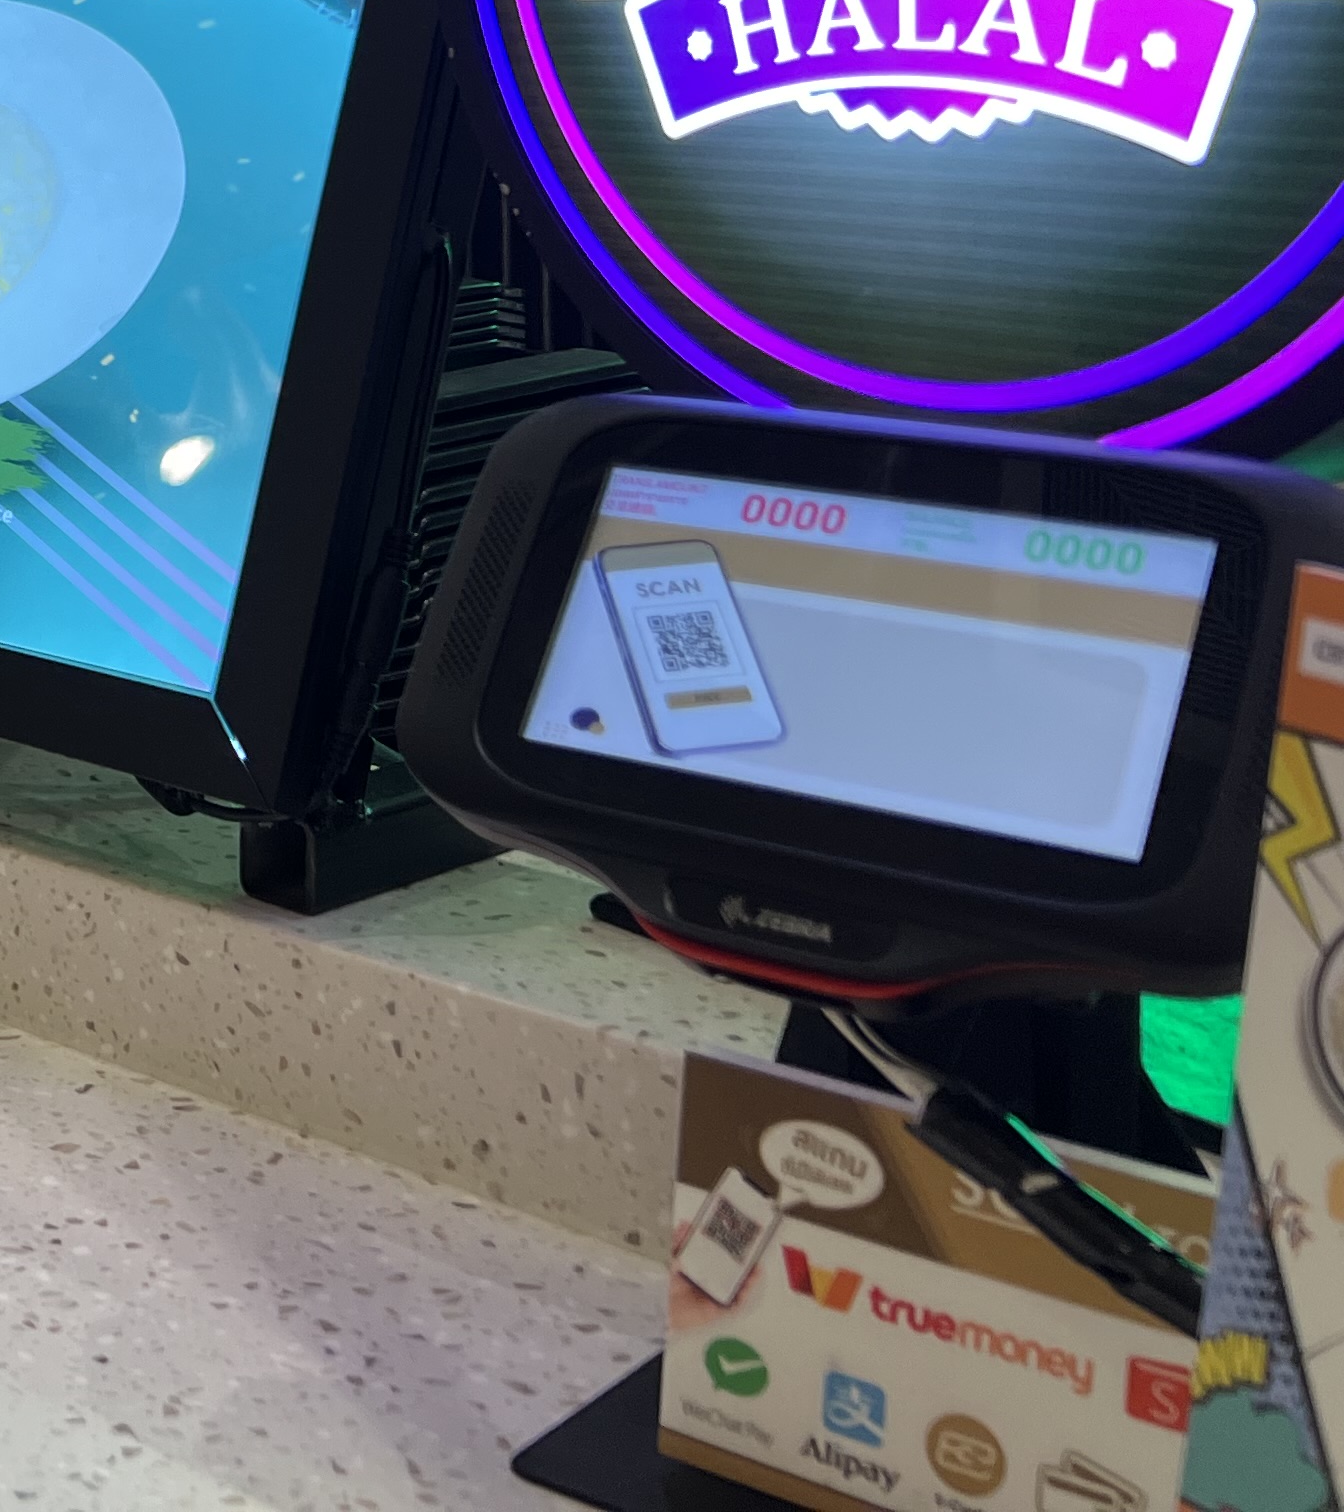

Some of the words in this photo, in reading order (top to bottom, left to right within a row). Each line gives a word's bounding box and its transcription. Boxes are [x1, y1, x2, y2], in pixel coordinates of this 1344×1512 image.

[741, 493, 846, 535] 0000
[1023, 526, 1145, 575] 0000
[635, 578, 702, 599] SCAN
[870, 1286, 1095, 1398] truemoney
[799, 1437, 901, 1492] Alipay
